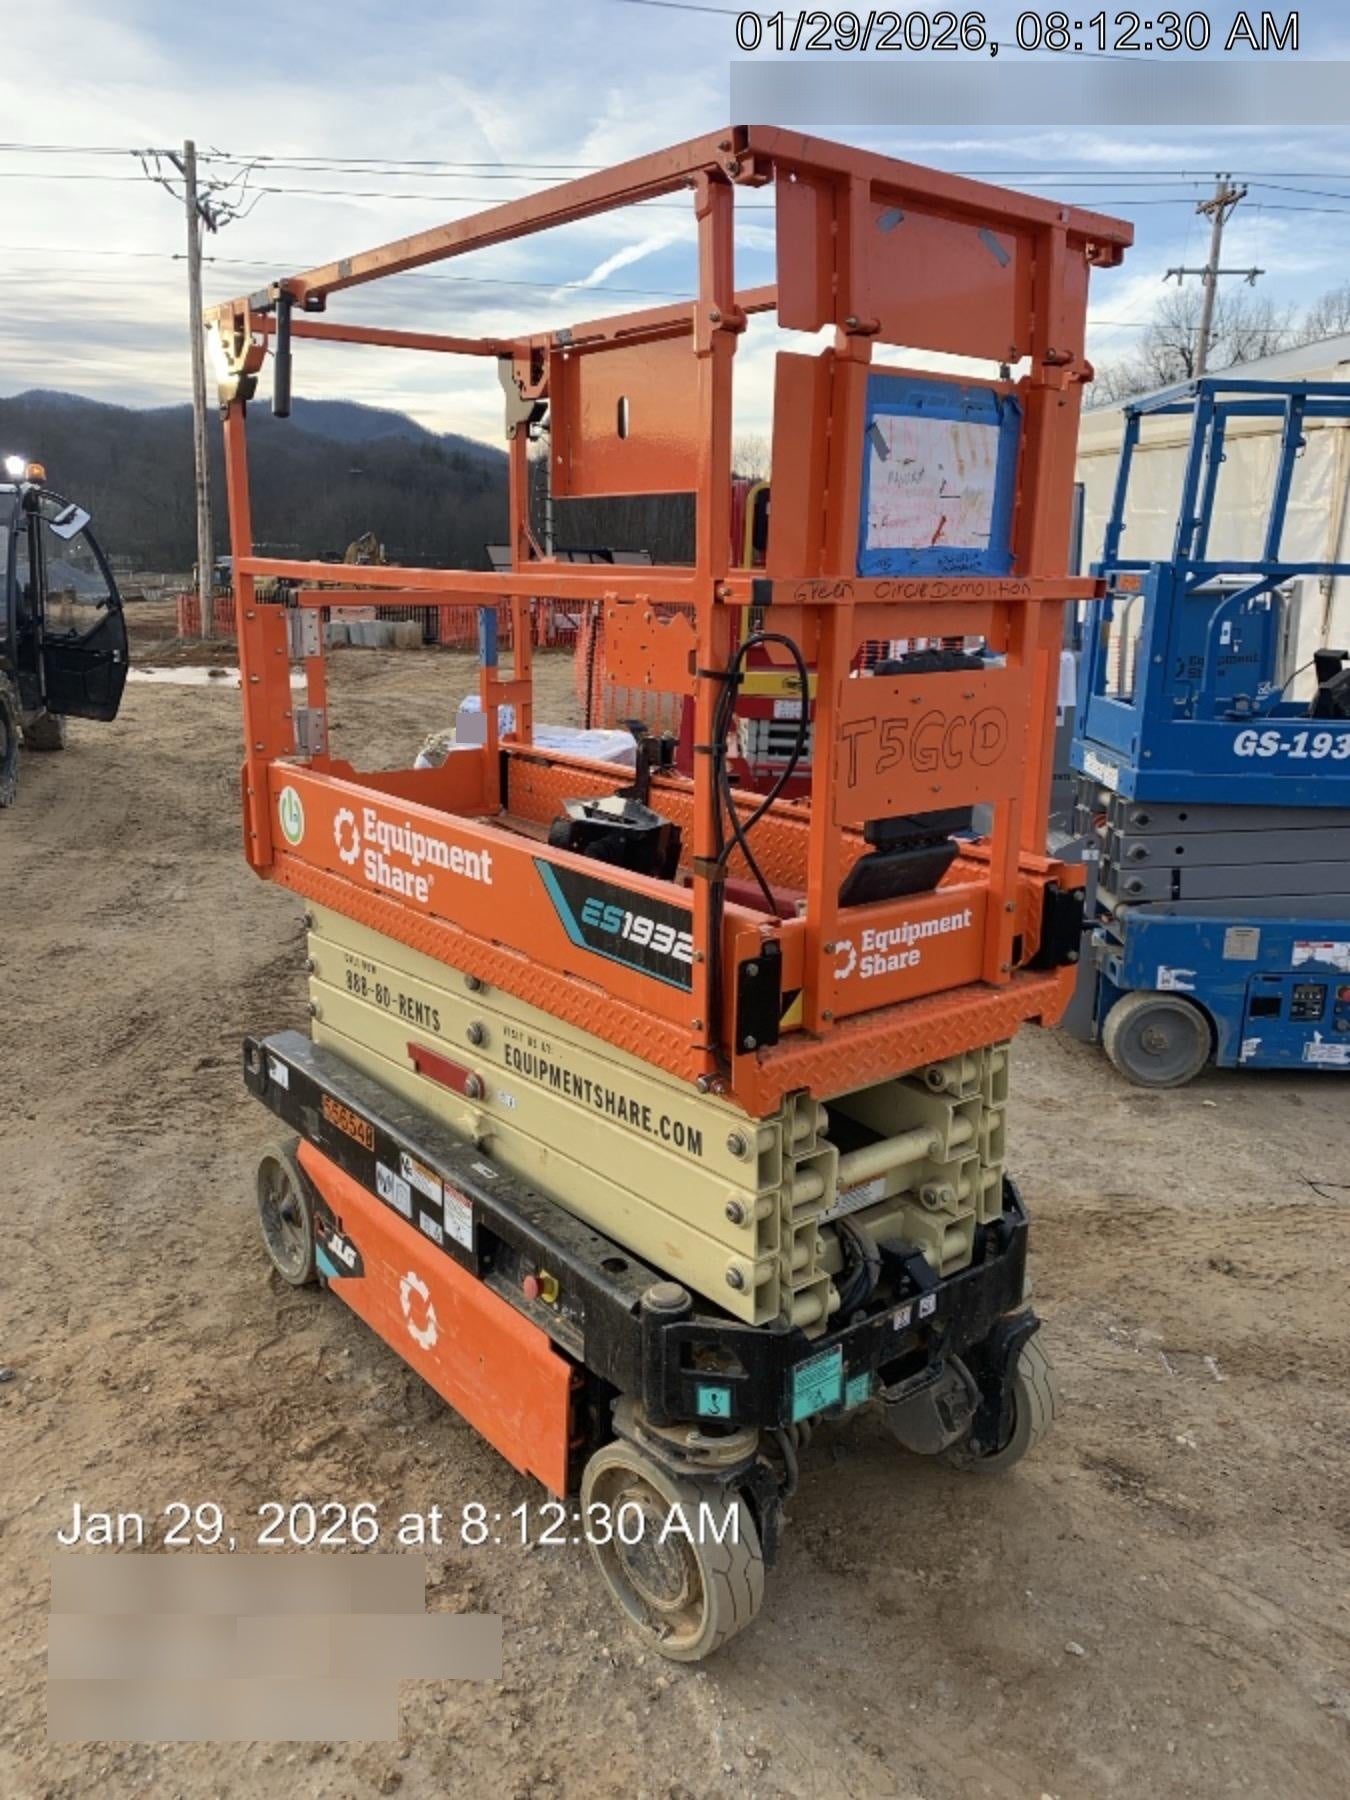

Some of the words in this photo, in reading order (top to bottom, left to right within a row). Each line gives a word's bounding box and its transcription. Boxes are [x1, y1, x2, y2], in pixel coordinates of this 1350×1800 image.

[841, 706, 1009, 789] T5GCD
[1233, 730, 1350, 759] GS-193
[363, 807, 493, 884] Equipment
[581, 897, 693, 964] ES1932
[861, 908, 972, 952] Equipment
[860, 949, 920, 979] Share
[346, 969, 441, 1032] 888-80-RENTS
[504, 1043, 703, 1157] EQUIPMENTSHARE.COM
